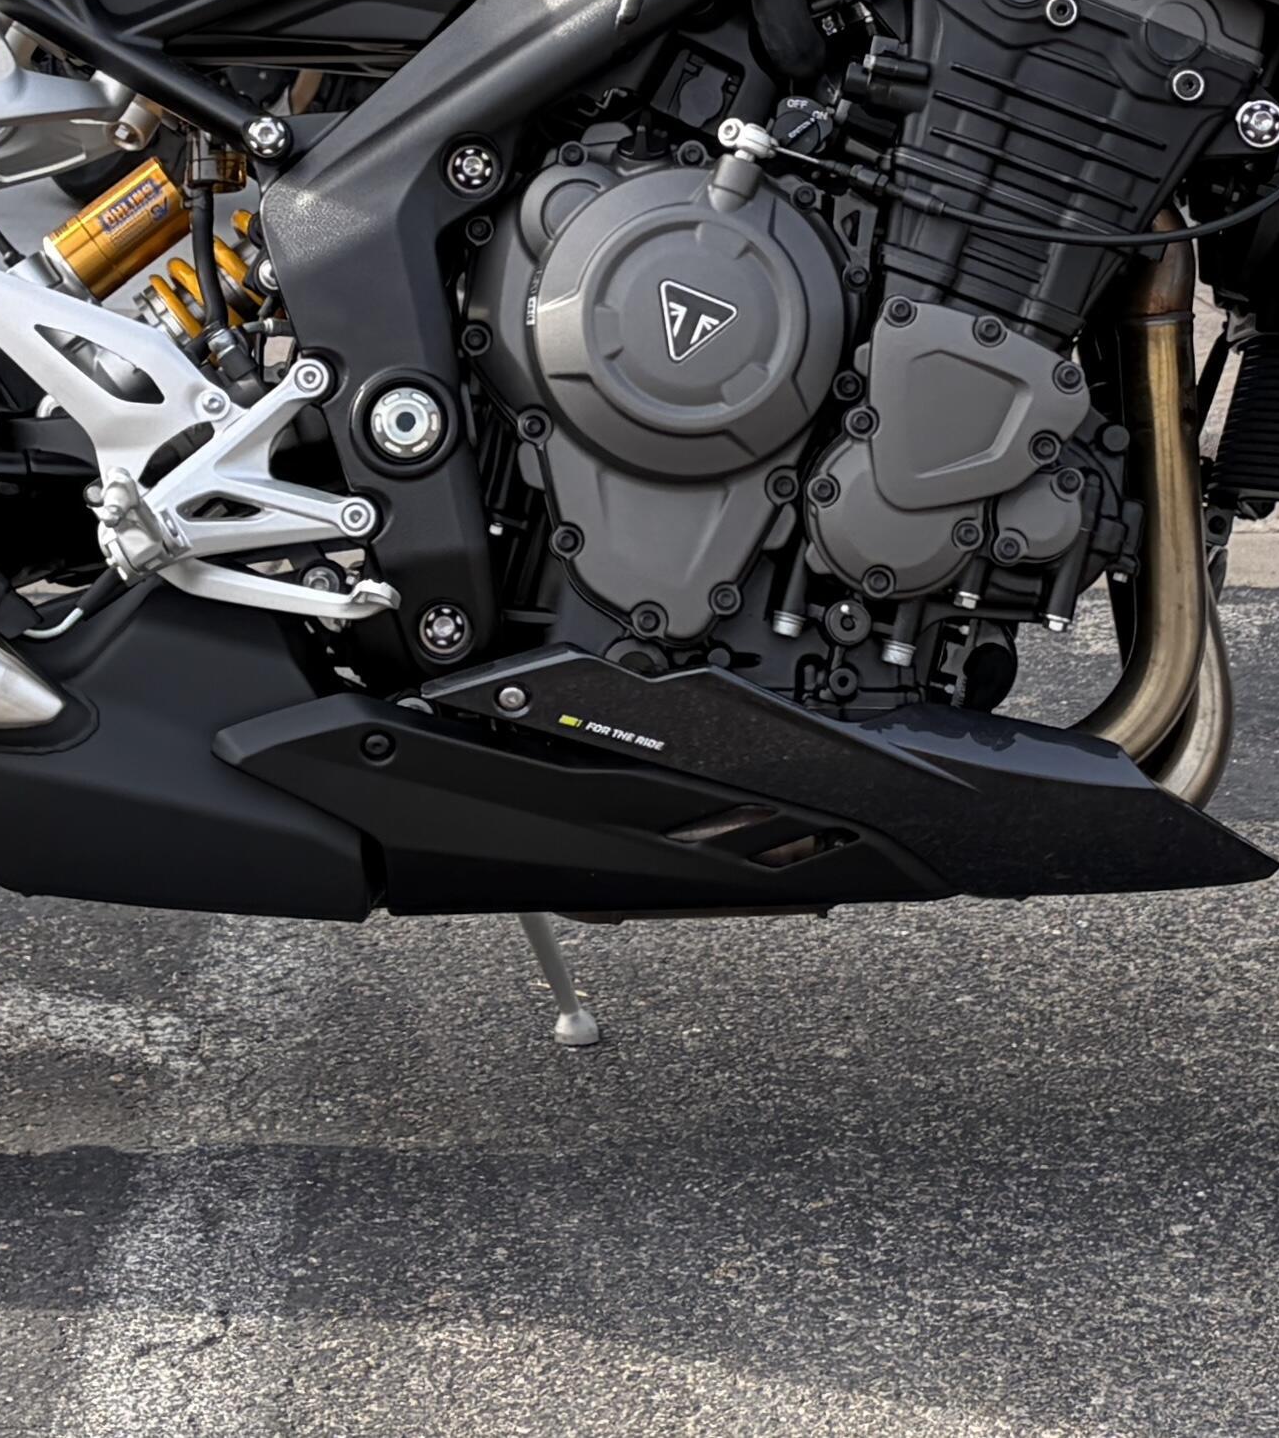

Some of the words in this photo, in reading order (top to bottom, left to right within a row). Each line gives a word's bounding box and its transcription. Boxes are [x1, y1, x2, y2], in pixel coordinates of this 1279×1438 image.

[585, 721, 610, 735] FOR
[611, 728, 635, 743] THE
[635, 735, 665, 750] RIDE
